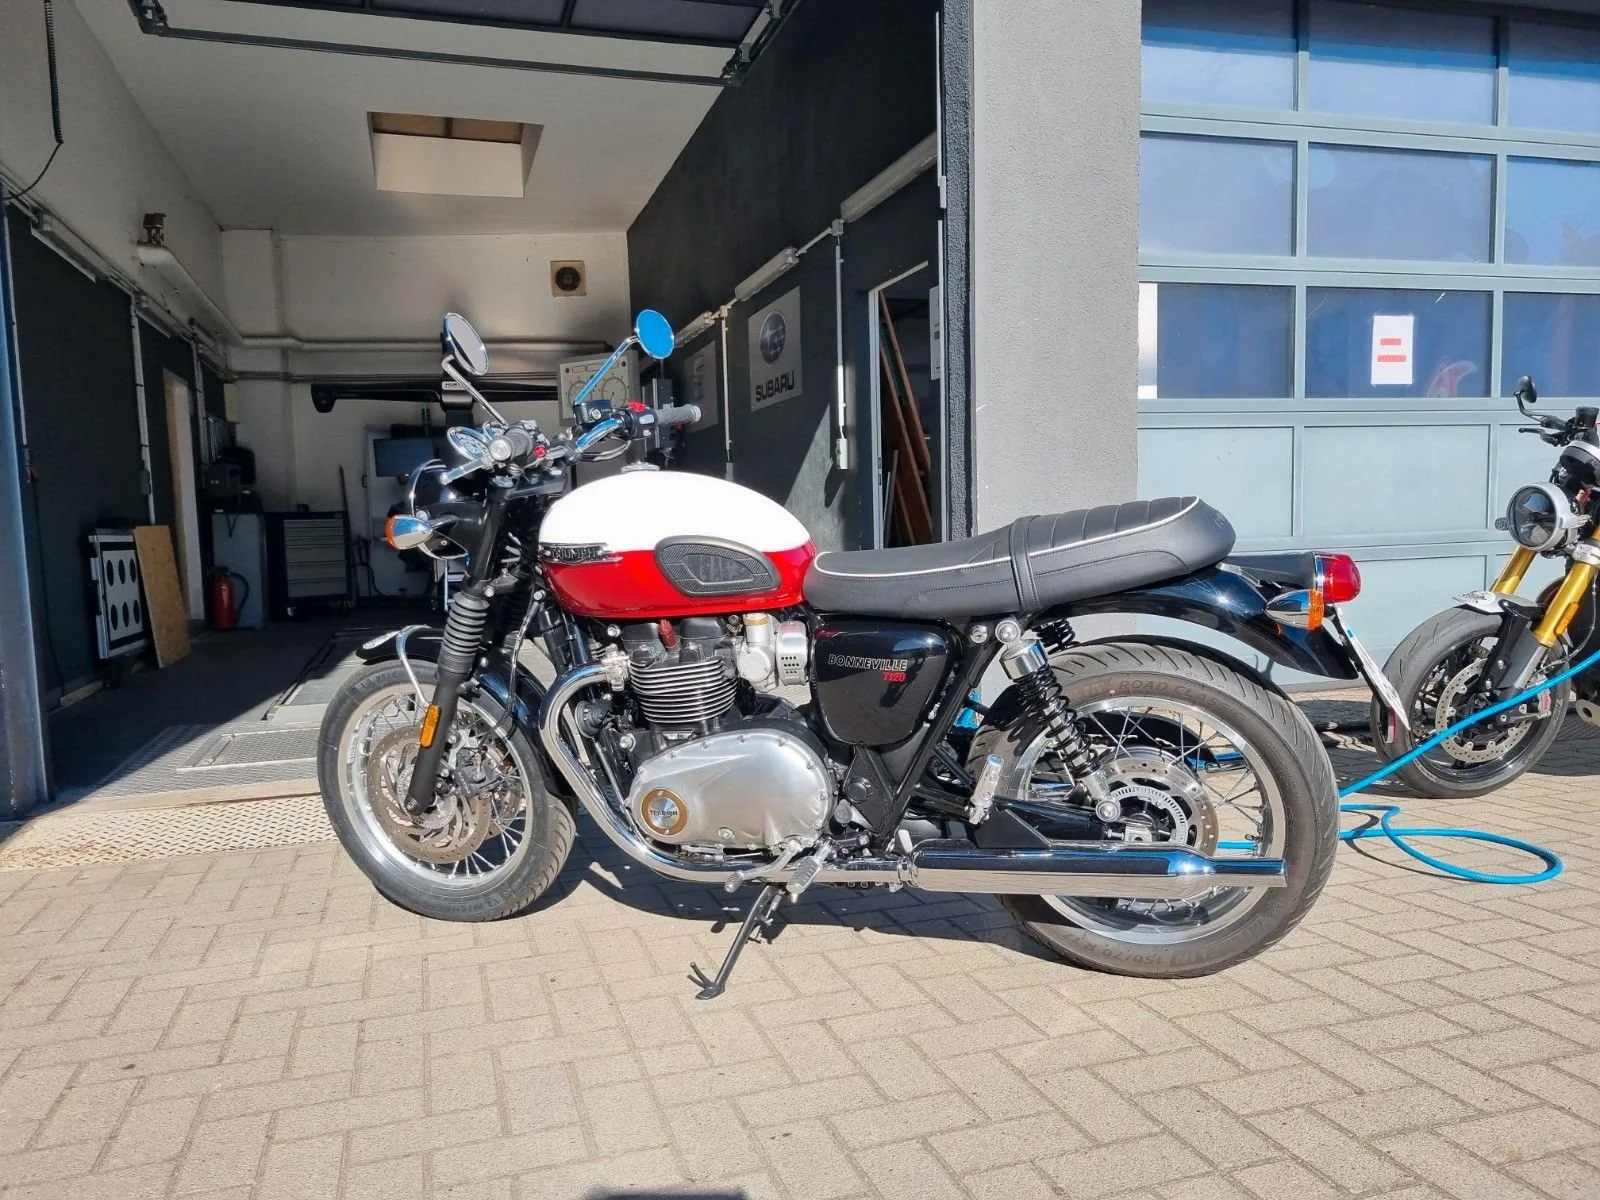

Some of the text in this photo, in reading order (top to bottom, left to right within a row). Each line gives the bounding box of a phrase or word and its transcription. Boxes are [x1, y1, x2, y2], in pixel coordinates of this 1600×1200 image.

[755, 370, 795, 402] SUBARU
[551, 546, 597, 559] TRIUMPH
[828, 653, 908, 672] BONNEVILLE
[883, 672, 907, 682] T120
[1118, 679, 1169, 692] ROAD
